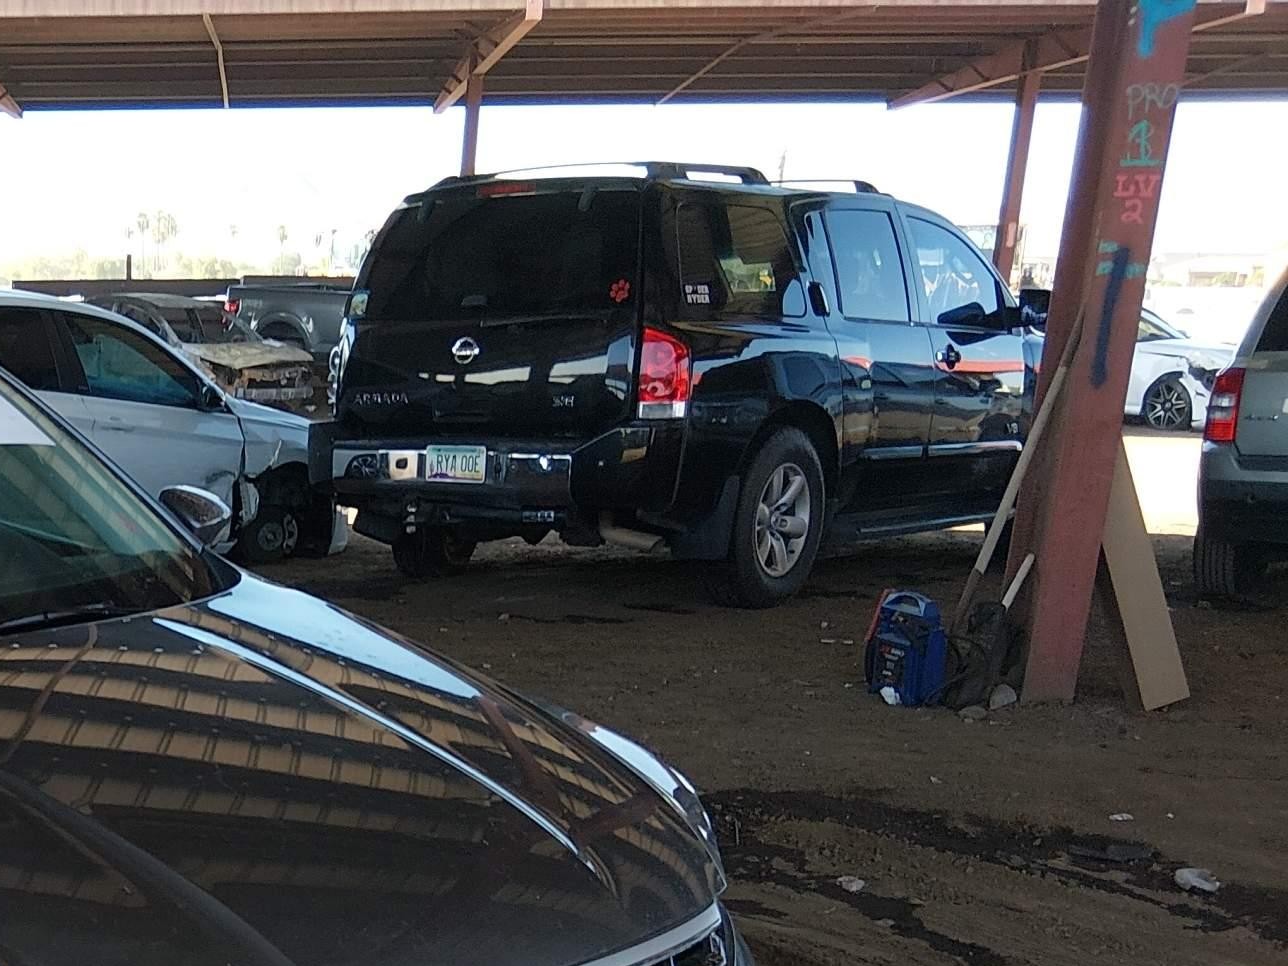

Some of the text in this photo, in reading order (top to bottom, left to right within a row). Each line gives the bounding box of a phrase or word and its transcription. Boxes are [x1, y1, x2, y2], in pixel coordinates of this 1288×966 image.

[1126, 82, 1178, 120] PRO
[1120, 198, 1144, 224] 2
[436, 454, 457, 473] RYA
